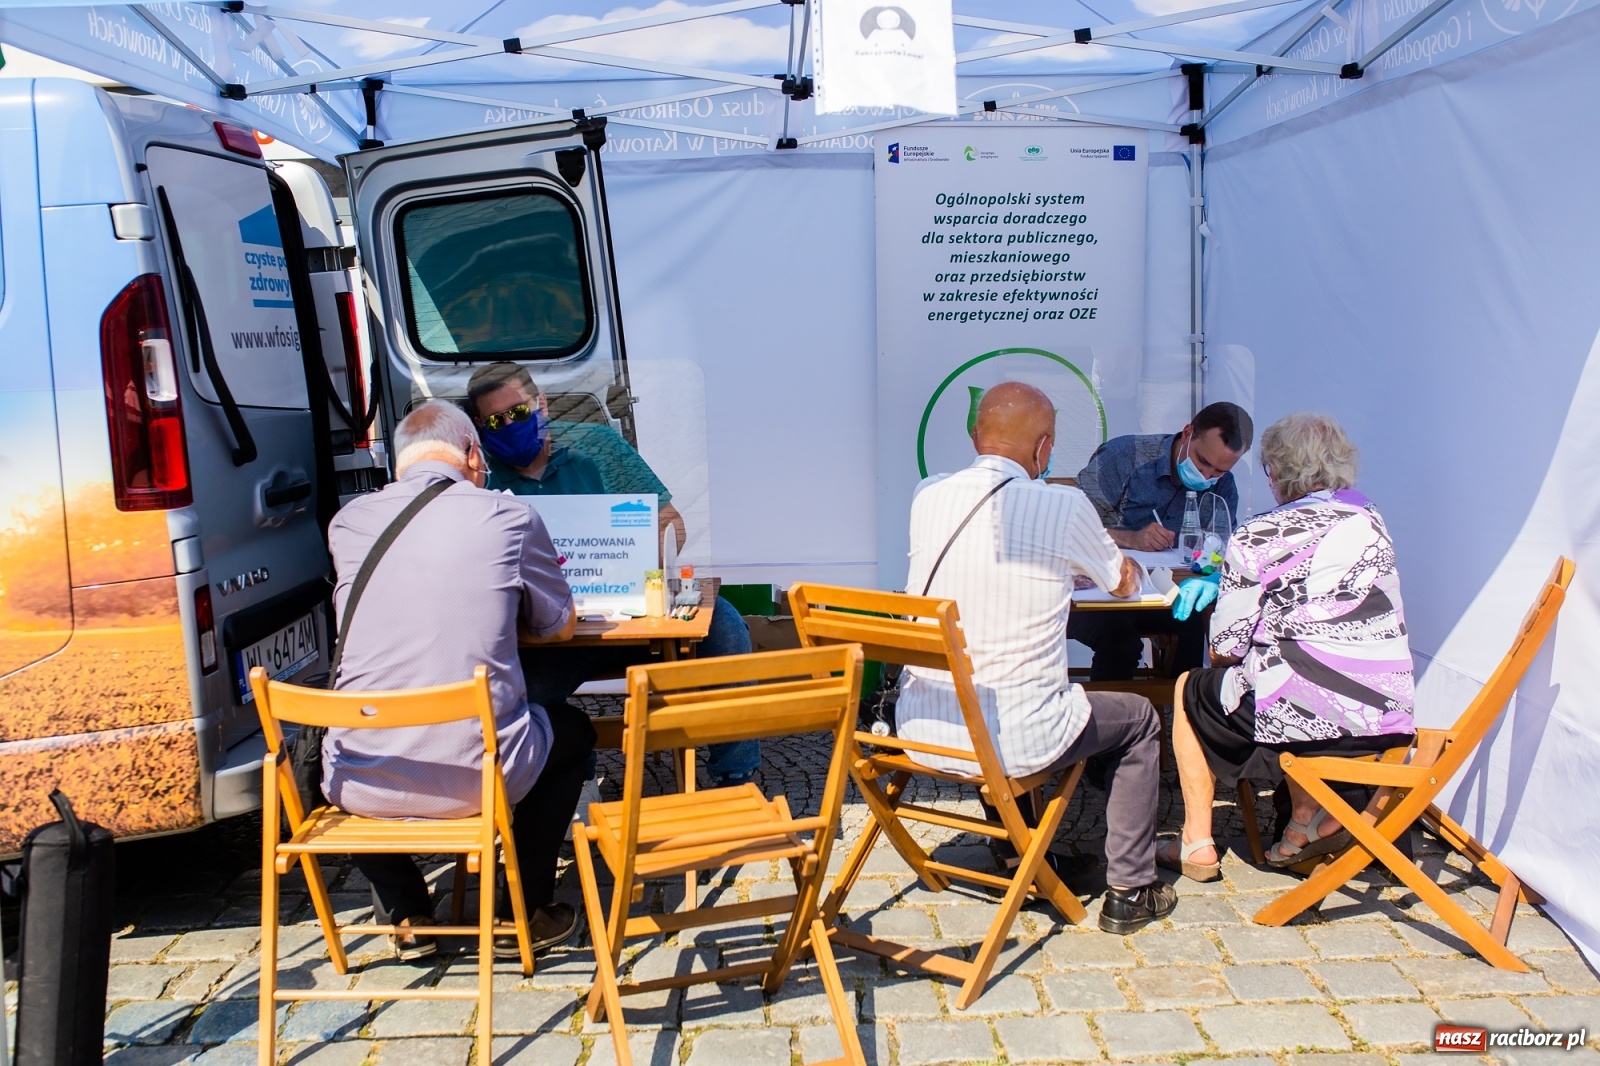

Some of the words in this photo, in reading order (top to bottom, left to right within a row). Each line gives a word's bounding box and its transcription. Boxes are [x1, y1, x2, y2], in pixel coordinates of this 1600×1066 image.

[935, 191, 1031, 208] Ogólnopolski
[1034, 193, 1085, 208] system
[933, 211, 998, 227] wsparcia
[1003, 211, 1087, 227] doradczego
[921, 231, 944, 244] dla
[948, 231, 1003, 244] sektora
[1006, 230, 1098, 247] publicznego,
[244, 251, 276, 269] czyste
[949, 250, 1070, 266] mieszkaniowego
[249, 272, 291, 297] zdrowy
[934, 272, 966, 283] oraz
[969, 269, 1086, 286] przedsiębiorstw
[922, 292, 935, 302] w
[938, 289, 998, 302] zakresie
[1002, 287, 1099, 304] efektywności
[927, 307, 1030, 324] energetycznej
[1032, 310, 1065, 321] oraz
[1068, 307, 1098, 320] OZE
[231, 326, 301, 352] www.wfosig
[589, 551, 629, 560] ramach
[562, 567, 603, 578] gramu
[273, 617, 315, 671] 6474M
